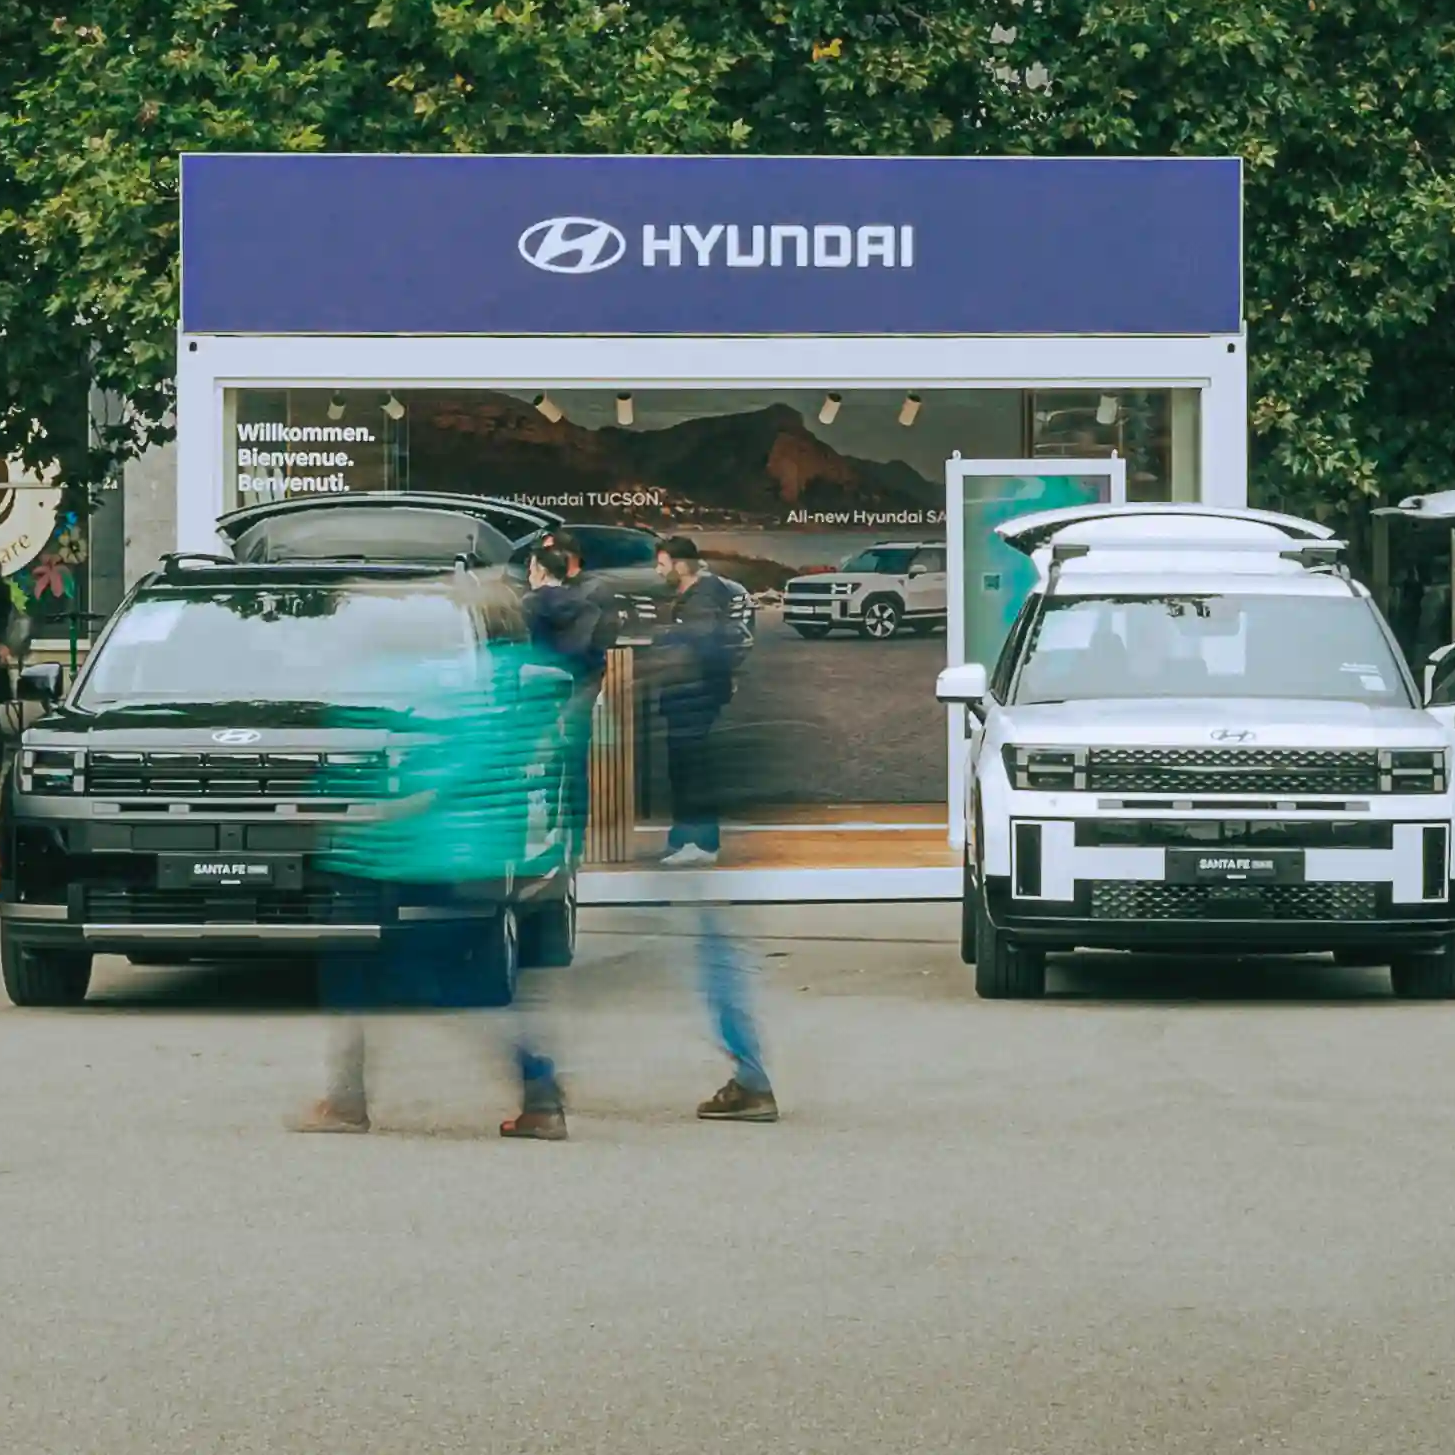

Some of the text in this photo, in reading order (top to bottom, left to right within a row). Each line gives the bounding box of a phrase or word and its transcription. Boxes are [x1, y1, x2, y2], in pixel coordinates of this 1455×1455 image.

[642, 224, 914, 268] HYUNDAI
[236, 422, 376, 442] Willkommen.
[237, 447, 355, 467] Bienvenue.
[237, 472, 350, 492] Benvenuti.
[513, 492, 585, 507] Hyundai
[587, 492, 663, 506] TUCSON.
[786, 509, 850, 524] All-new
[853, 509, 923, 527] Hyundai
[193, 863, 231, 875] SANTA
